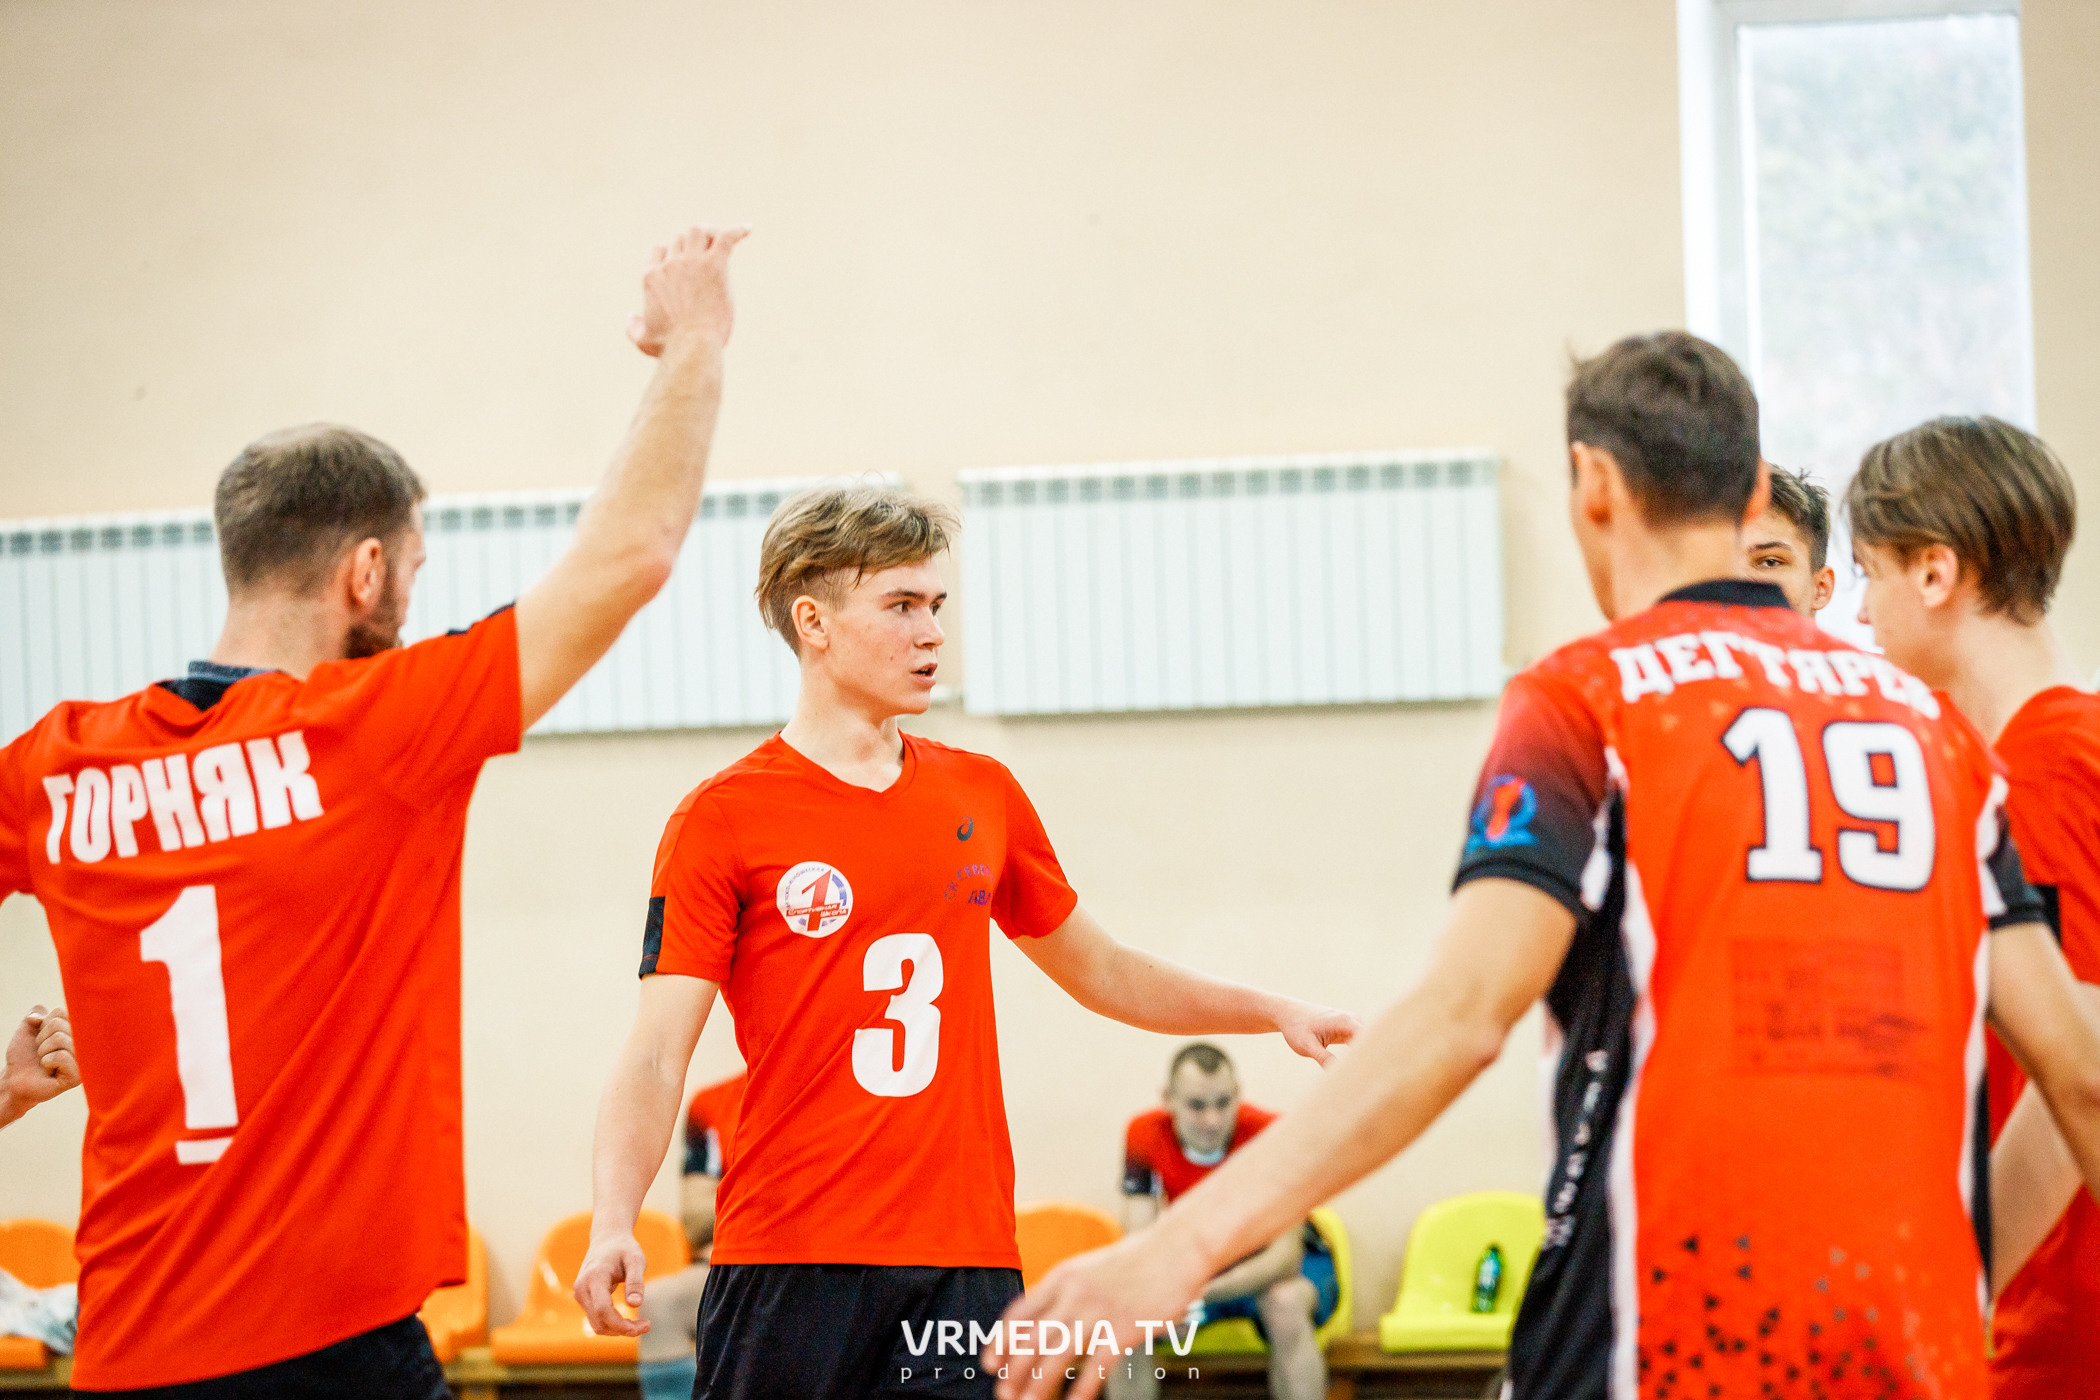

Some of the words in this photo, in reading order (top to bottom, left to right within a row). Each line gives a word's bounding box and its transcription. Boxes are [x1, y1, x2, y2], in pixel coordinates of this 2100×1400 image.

[42, 730, 325, 865] ГОРНЯК
[1719, 706, 1937, 893] 19
[139, 884, 239, 1130] 1
[851, 933, 944, 1097] 3
